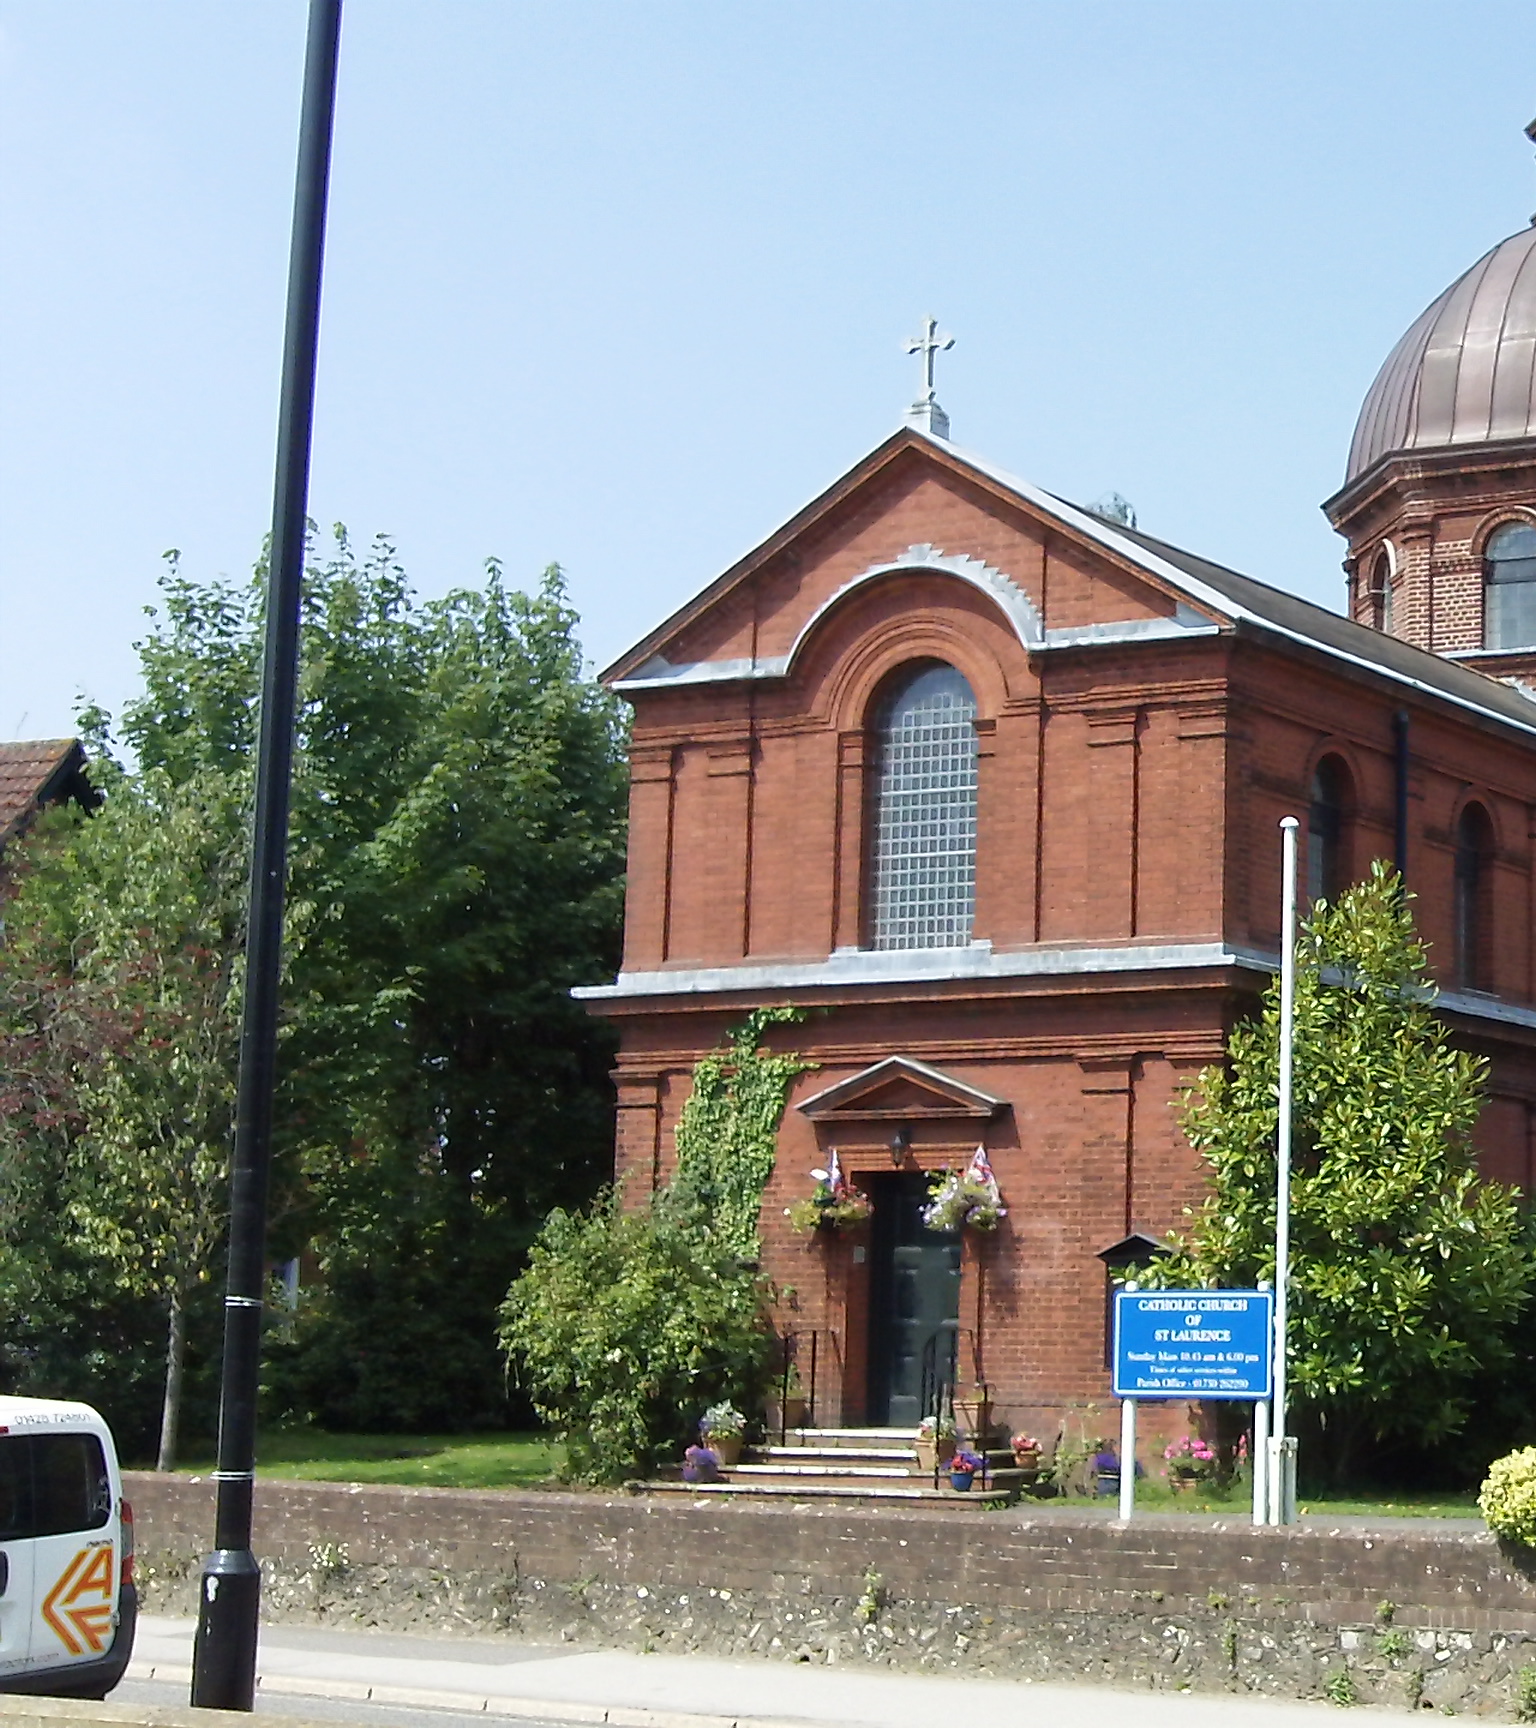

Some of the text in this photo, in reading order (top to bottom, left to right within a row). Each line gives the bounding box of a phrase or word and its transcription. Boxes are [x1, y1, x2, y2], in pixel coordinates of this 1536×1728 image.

[1138, 1299, 1248, 1311] CATHOLIC CHURCH
[1184, 1314, 1202, 1326] OF
[1154, 1330, 1231, 1342] ST LAURENCE
[1127, 1351, 1156, 1363] Sunday
[1158, 1351, 1178, 1361] Mass
[1217, 1352, 1225, 1362] &
[1245, 1354, 1259, 1364] pm
[1137, 1377, 1161, 1388] Parish
[1162, 1377, 1187, 1388] Office
